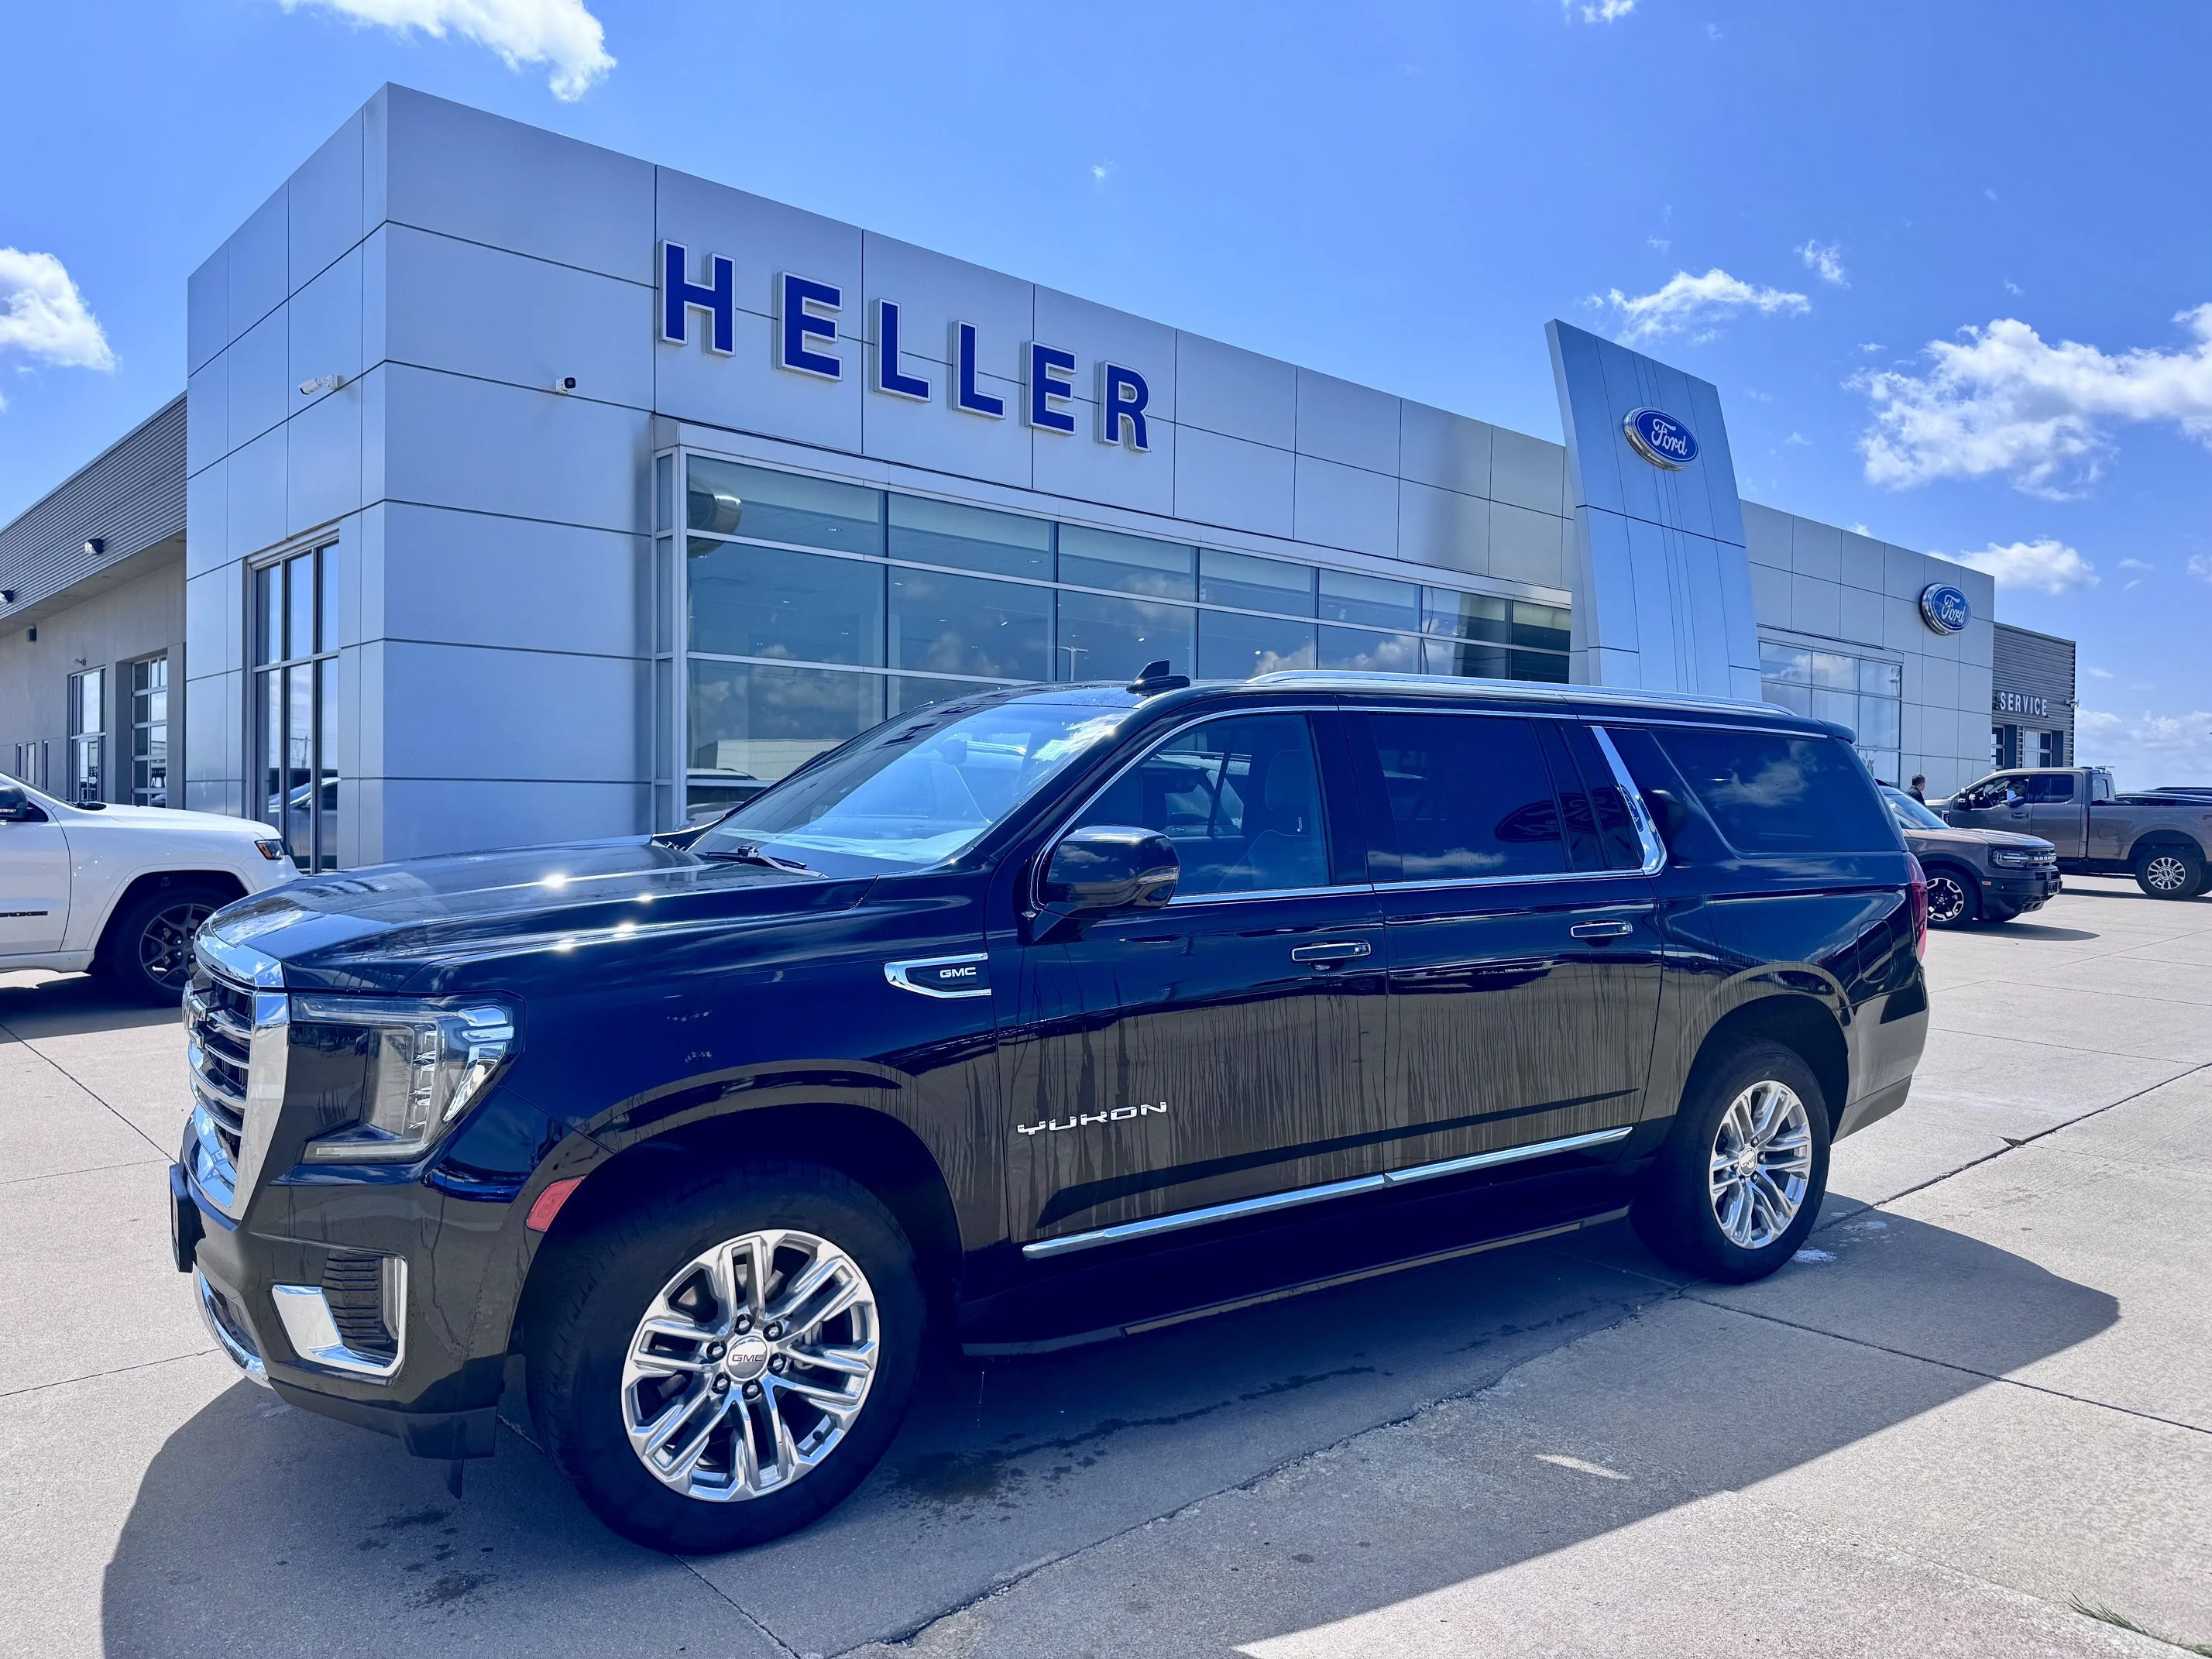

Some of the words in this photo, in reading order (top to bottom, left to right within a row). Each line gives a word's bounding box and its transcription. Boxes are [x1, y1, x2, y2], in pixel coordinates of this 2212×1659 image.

[656, 239, 1152, 453] HELLER
[1650, 418, 1688, 455] Ford
[1941, 594, 1966, 624] Ford
[2000, 692, 2048, 716] SERVICE
[939, 967, 977, 979] GMC
[1016, 1101, 1168, 1135] YUKON
[732, 1354, 765, 1362] GMC
